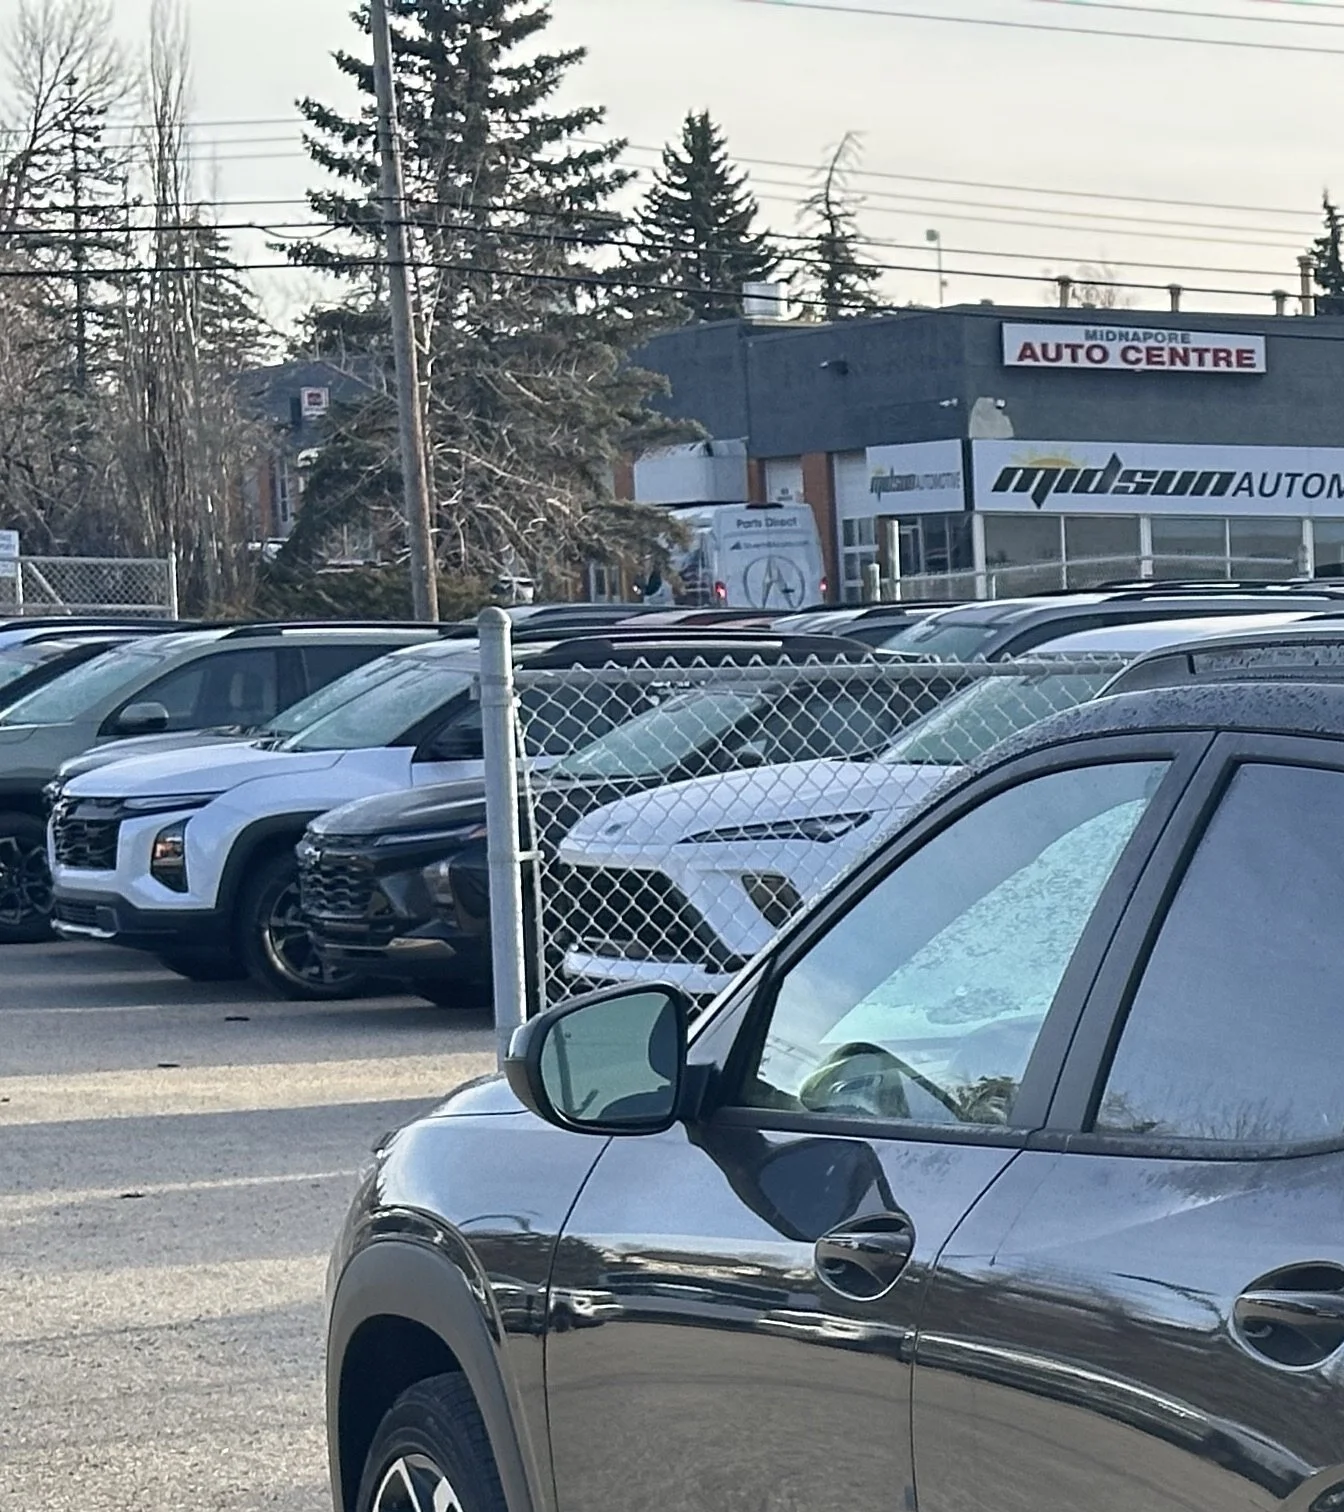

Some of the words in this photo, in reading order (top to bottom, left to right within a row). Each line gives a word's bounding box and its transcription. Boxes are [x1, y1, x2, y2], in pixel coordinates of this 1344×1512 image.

[1084, 328, 1192, 344] MIDNAPORE
[1017, 342, 1110, 365] AUTO
[1120, 345, 1257, 369] CENTRE
[991, 452, 1237, 510] midsun
[736, 518, 762, 529] Parts
[764, 516, 797, 527] Direct
